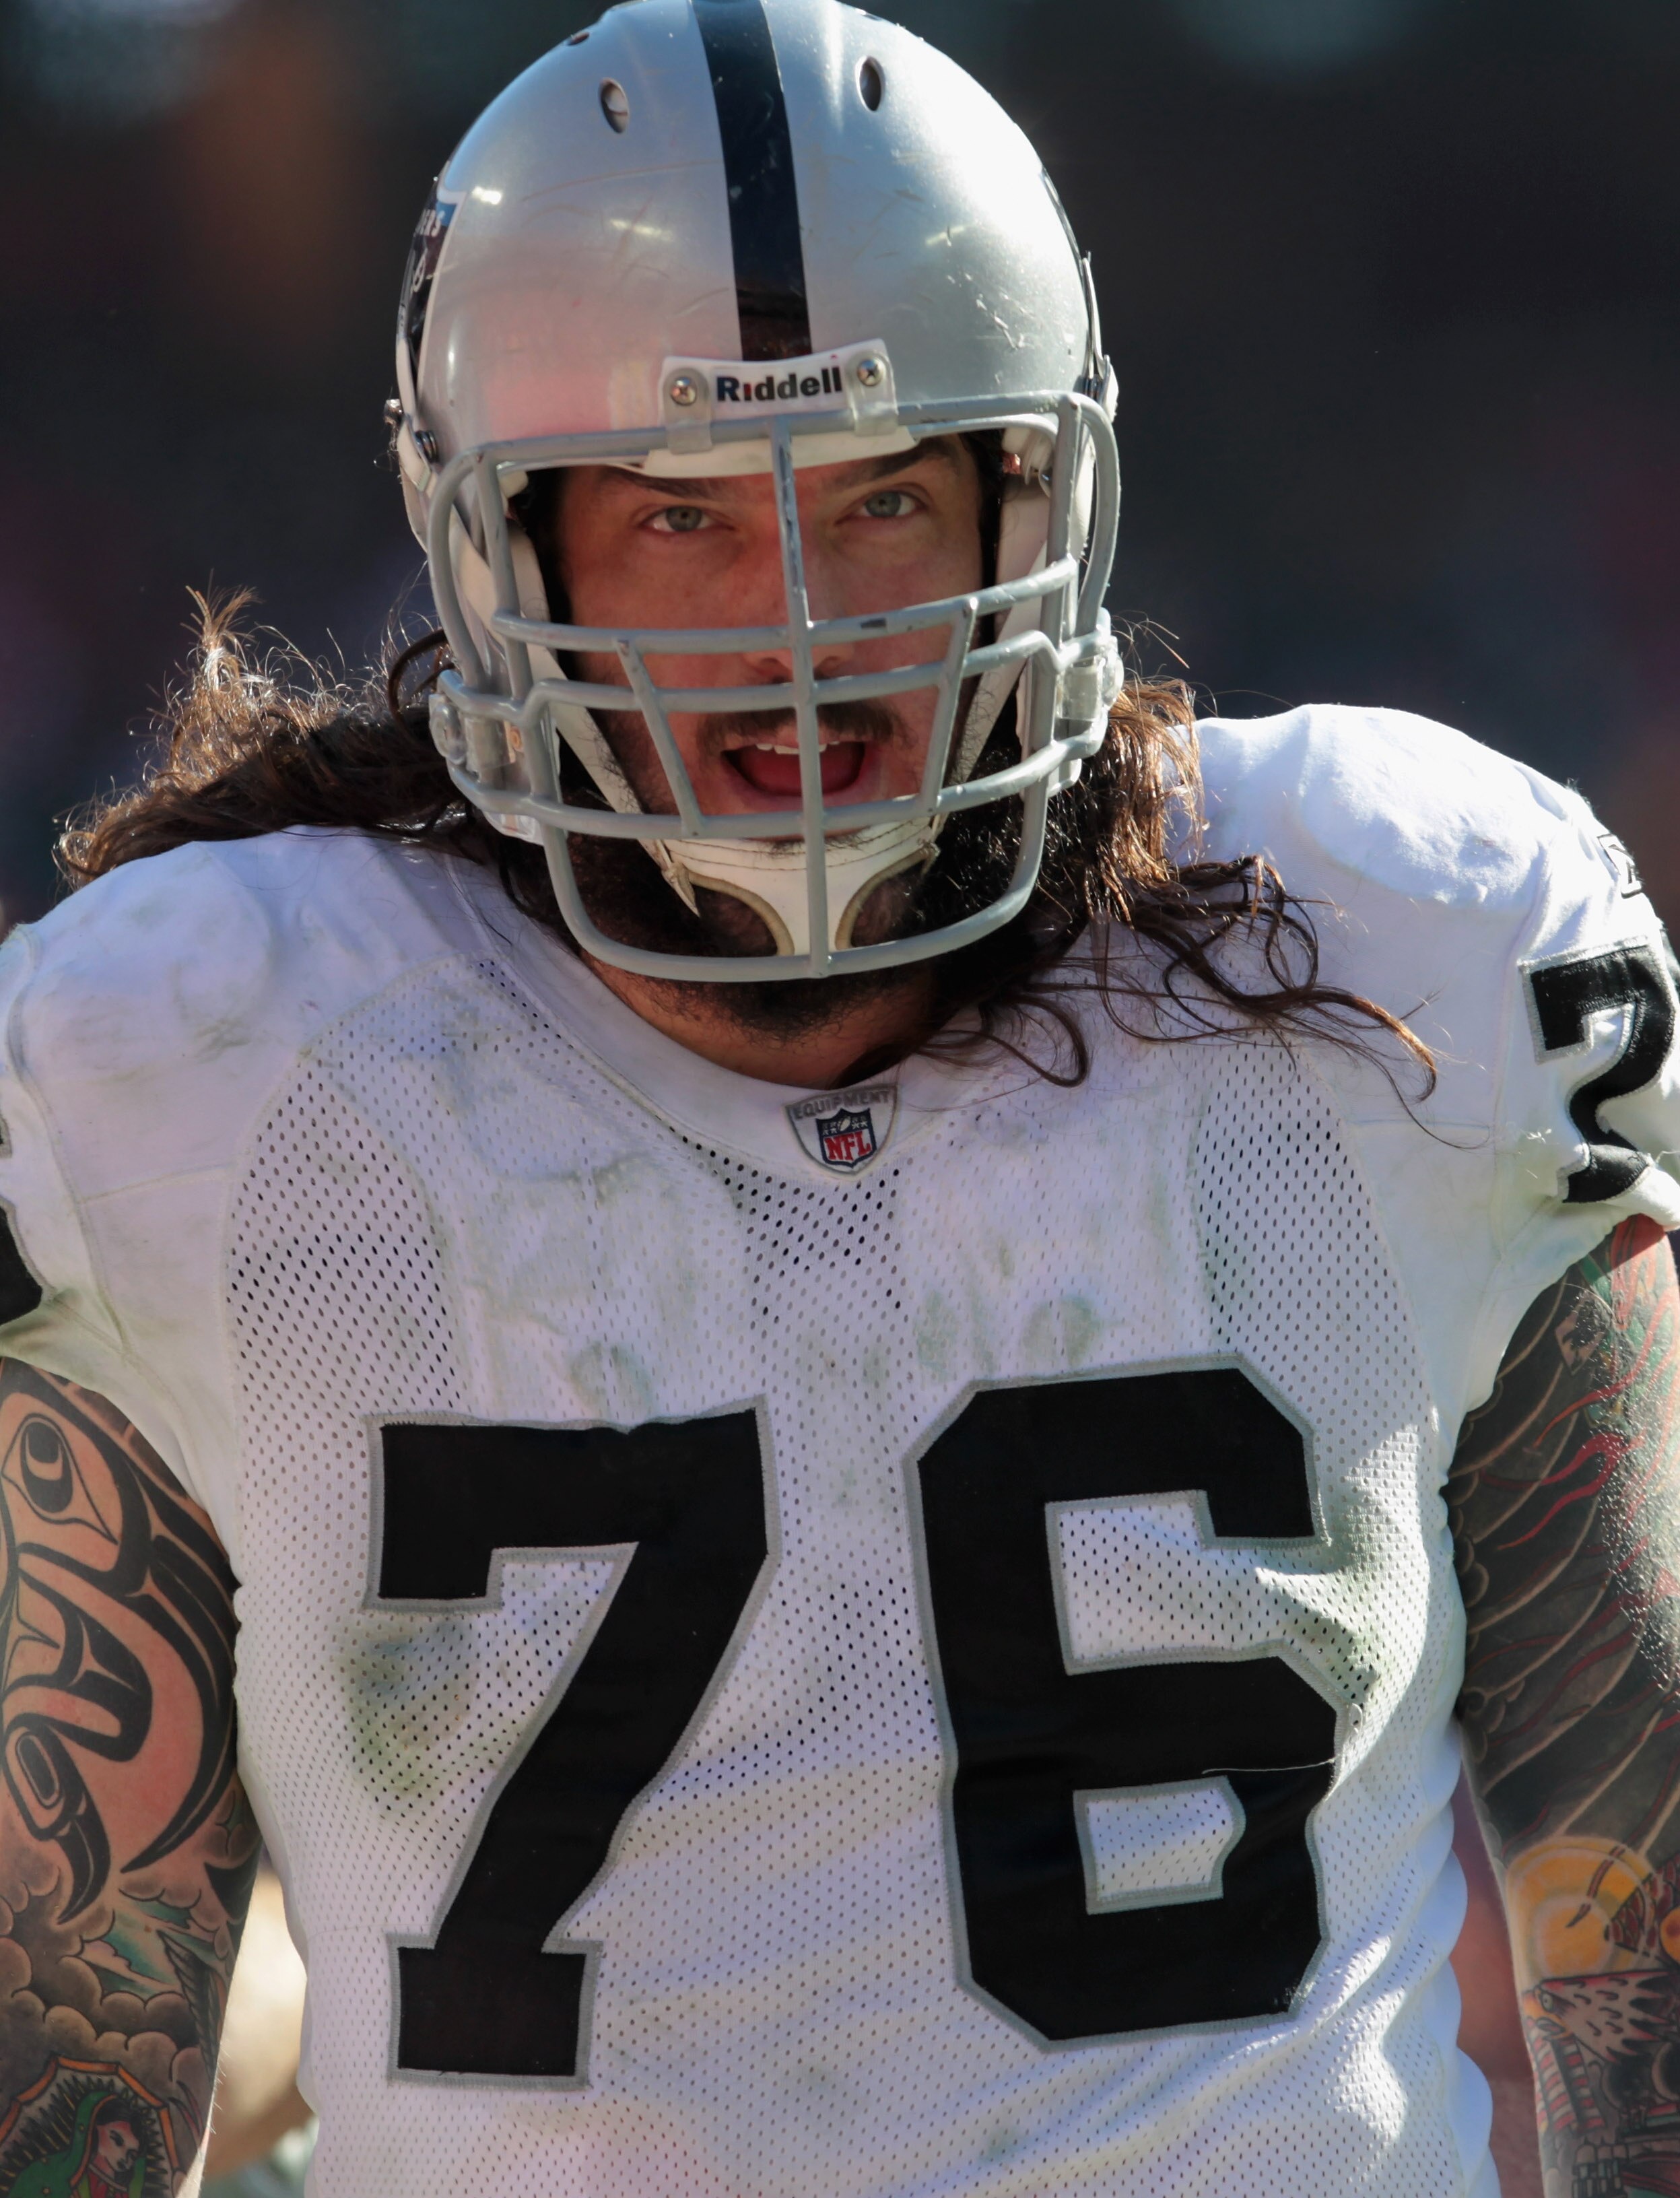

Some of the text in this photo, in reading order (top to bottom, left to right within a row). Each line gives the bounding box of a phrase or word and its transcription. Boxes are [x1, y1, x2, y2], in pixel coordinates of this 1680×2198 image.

[716, 365, 843, 402] Riddell
[792, 1089, 890, 1121] EQUIPMENT
[823, 1131, 872, 1161] NFL
[364, 1352, 1343, 2090] 76
